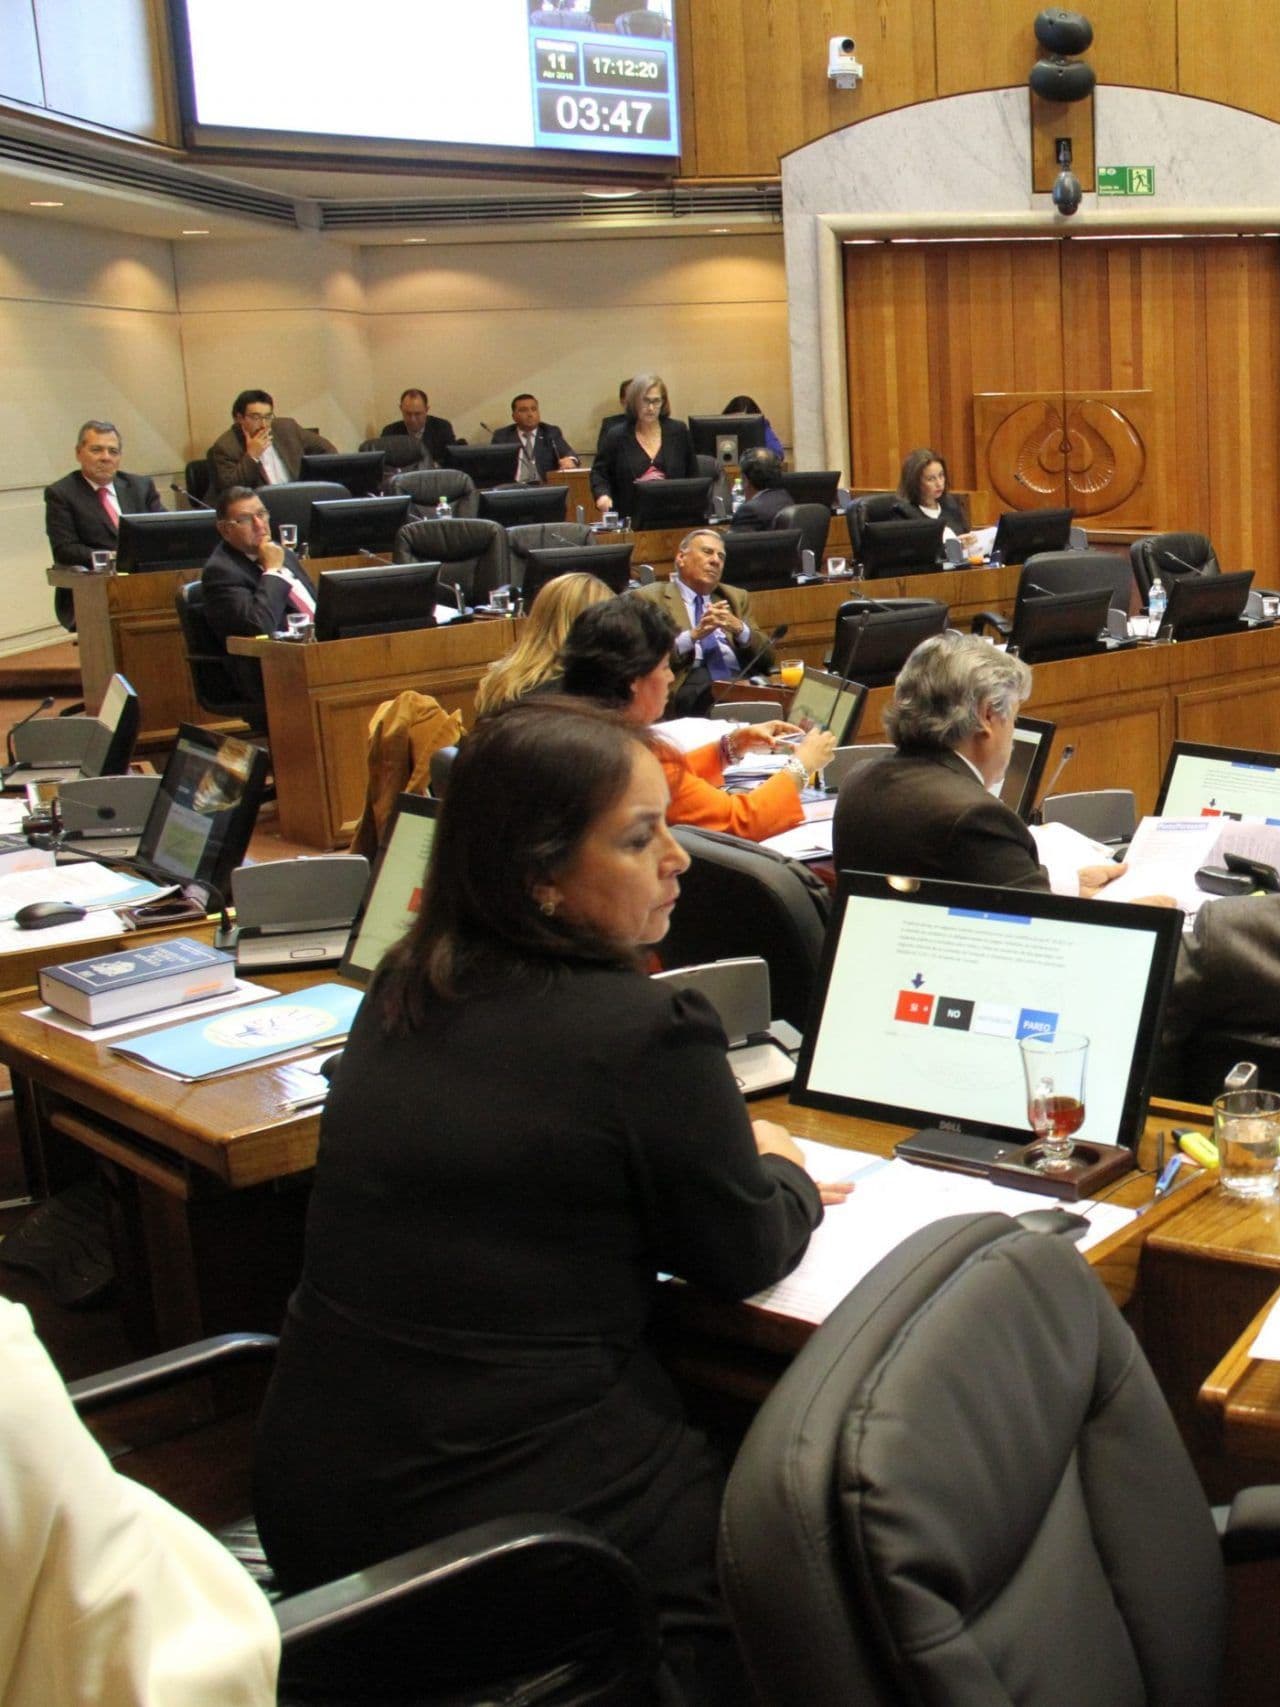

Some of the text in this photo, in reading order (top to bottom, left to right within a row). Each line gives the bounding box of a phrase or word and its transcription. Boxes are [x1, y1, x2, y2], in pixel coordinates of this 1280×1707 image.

[547, 53, 566, 70] 11
[592, 57, 658, 79] 17:12:20
[556, 95, 653, 134] 03:47
[946, 1008, 962, 1019] NO
[1022, 1019, 1051, 1032] PAREO
